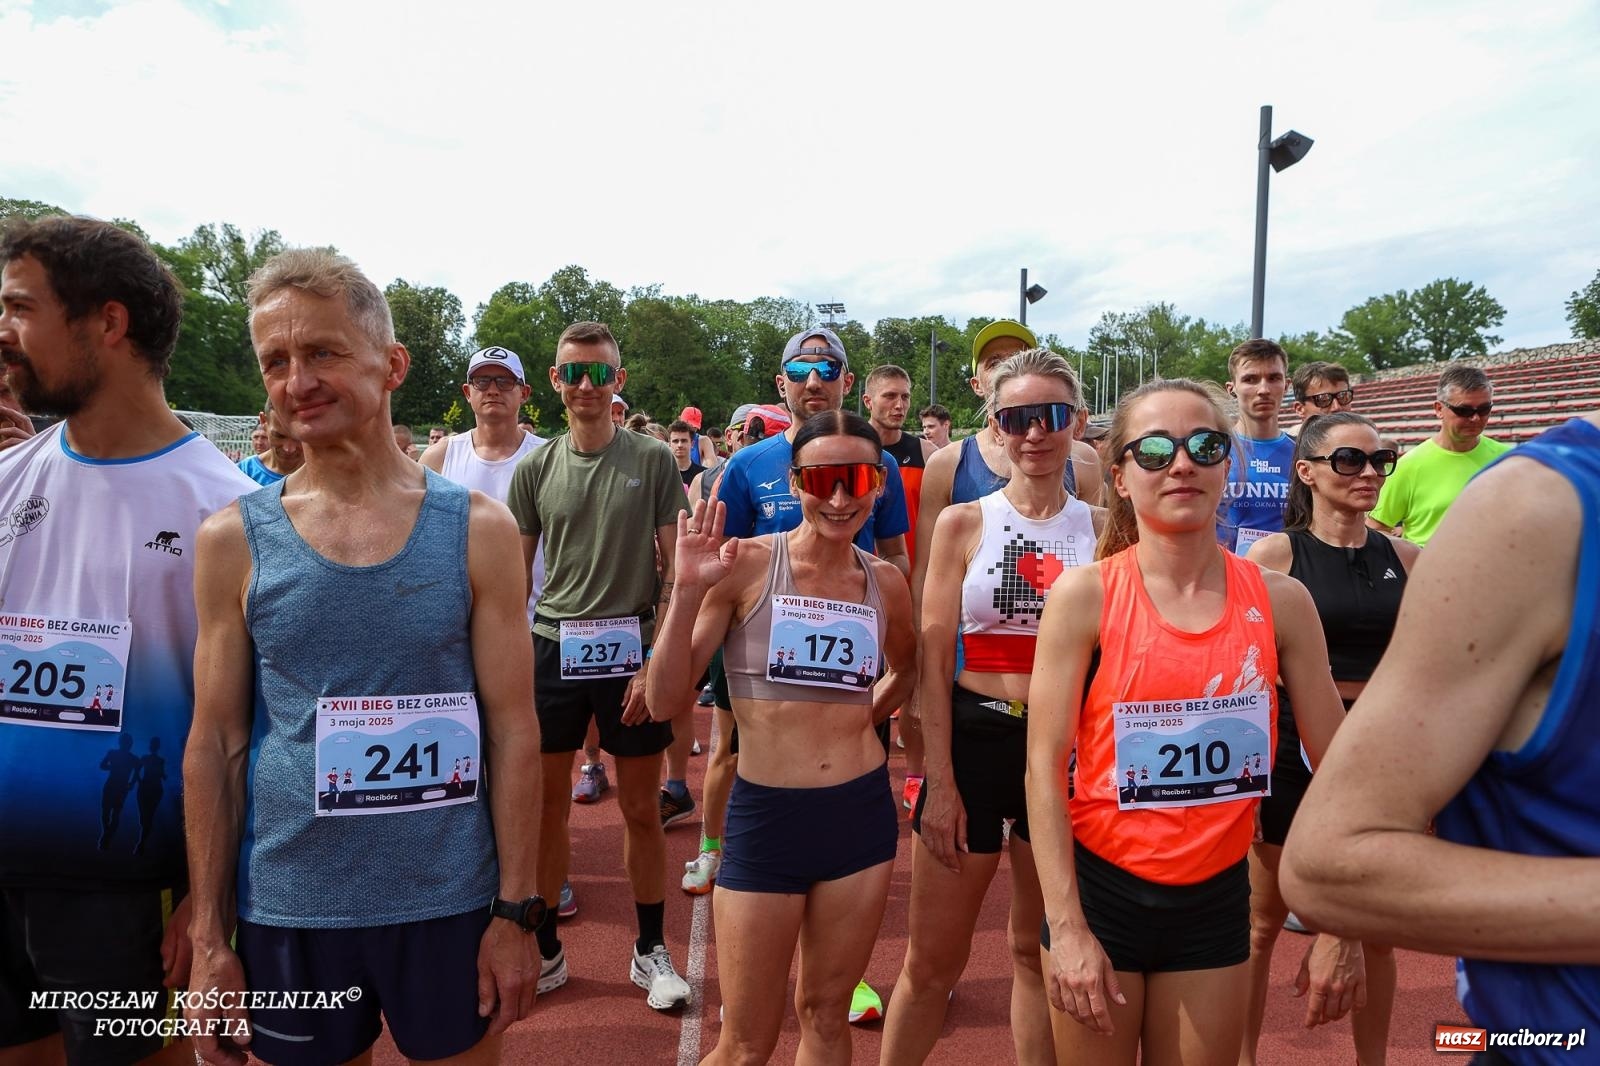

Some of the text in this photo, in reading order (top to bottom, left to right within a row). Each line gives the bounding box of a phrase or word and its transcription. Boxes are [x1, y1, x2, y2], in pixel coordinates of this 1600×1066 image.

[1223, 482, 1289, 498] UNNE
[782, 597, 801, 606] XVII
[803, 600, 825, 609] BIEG
[826, 602, 845, 612] BEZ
[845, 606, 874, 618] GRANIC
[788, 611, 806, 619] maja
[807, 612, 825, 621] 2025
[20, 618, 45, 628] BIEG
[47, 620, 68, 631] BEZ
[71, 622, 120, 635] GRANIC
[1, 634, 21, 643] maja
[23, 634, 43, 643] 2025
[580, 642, 621, 663] 237
[804, 634, 854, 665] 173
[9, 659, 86, 699] 205
[331, 696, 468, 711] XVII BIEG BEZ GRANIC
[1125, 704, 1149, 714] XVII
[1153, 703, 1182, 713] BIEG
[1186, 701, 1209, 711] BEZ
[1212, 695, 1257, 709] GRANIC
[330, 717, 394, 728] 3 maja 2025
[1133, 720, 1157, 730] maja
[1160, 719, 1183, 727] 2025
[364, 741, 439, 782] 241
[1158, 740, 1230, 778] 210
[1161, 788, 1191, 796] Racibórz
